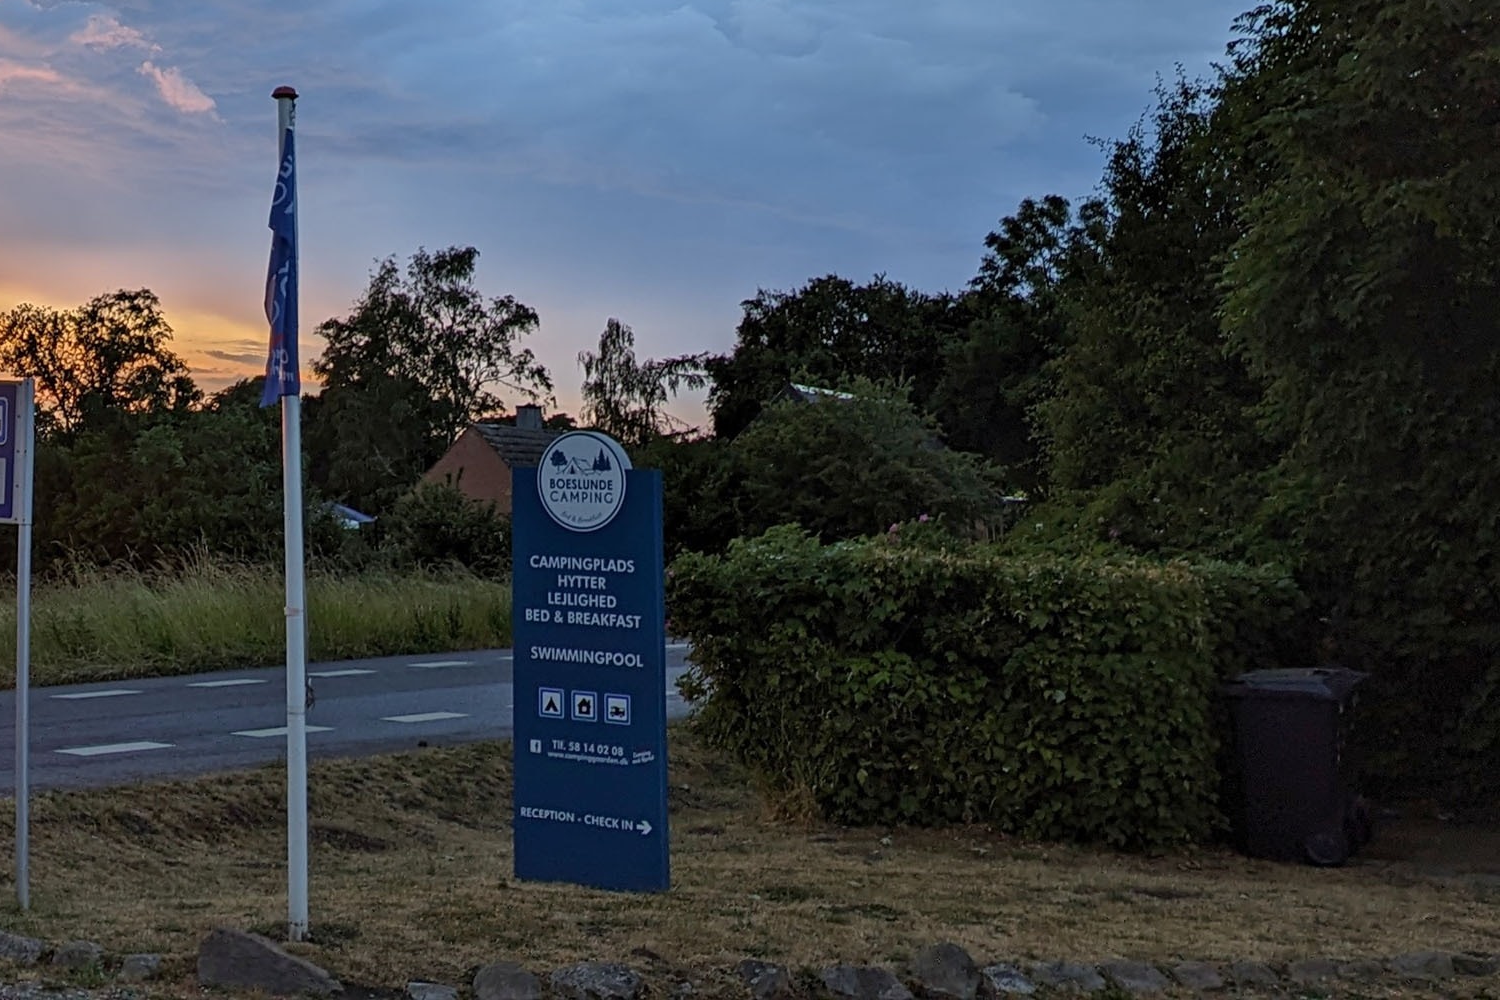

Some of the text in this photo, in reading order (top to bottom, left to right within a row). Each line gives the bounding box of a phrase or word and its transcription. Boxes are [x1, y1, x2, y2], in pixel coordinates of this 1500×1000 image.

[549, 478, 613, 491] BOESLUNDE
[549, 490, 613, 504] CAMPING
[529, 555, 635, 573] CAMPINGPLADS
[557, 575, 606, 589] HYTTER
[547, 592, 617, 608] LEJLIGHED
[525, 608, 641, 629] BED & BREAKFAST
[530, 646, 644, 668] SWIMMINGPOOL
[568, 742, 581, 752] 58
[583, 743, 595, 754] 14
[597, 745, 609, 755] 02
[611, 746, 624, 757] 08
[520, 807, 575, 823] RECEPTION
[584, 814, 619, 829] CHECK
[621, 820, 634, 831] IN
